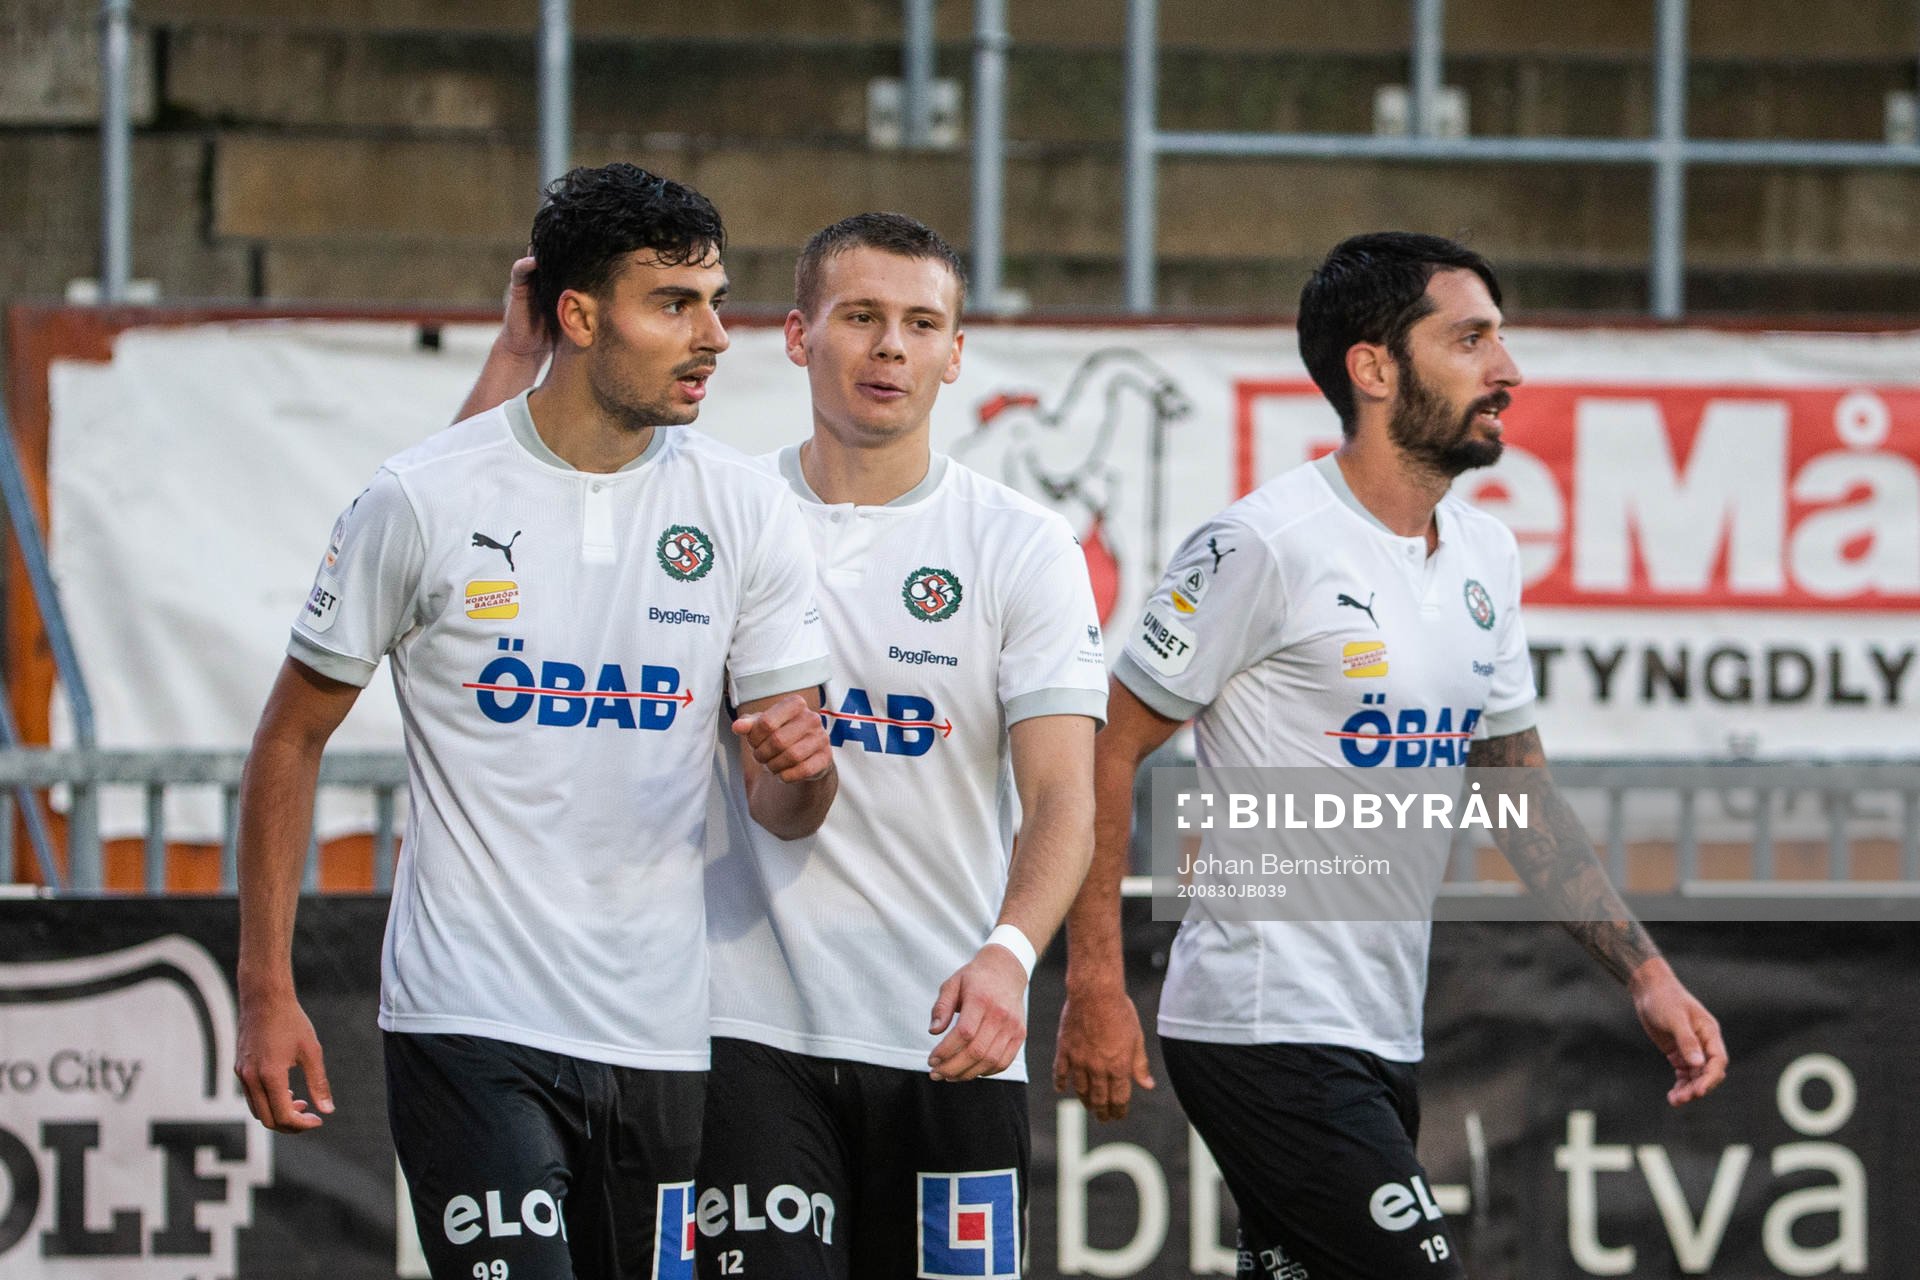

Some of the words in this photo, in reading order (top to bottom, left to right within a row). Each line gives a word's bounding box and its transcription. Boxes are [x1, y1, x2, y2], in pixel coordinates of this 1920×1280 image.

[648, 606, 710, 625] ByggTema
[1143, 611, 1189, 657] UNIBET
[888, 645, 958, 667] ByggTema
[476, 637, 681, 731] ÖBAB
[48, 1048, 143, 1102] City
[1553, 1052, 1870, 1278] två
[717, 1249, 745, 1276] 12
[1420, 1234, 1450, 1263] 19
[472, 1258, 509, 1280] 99
